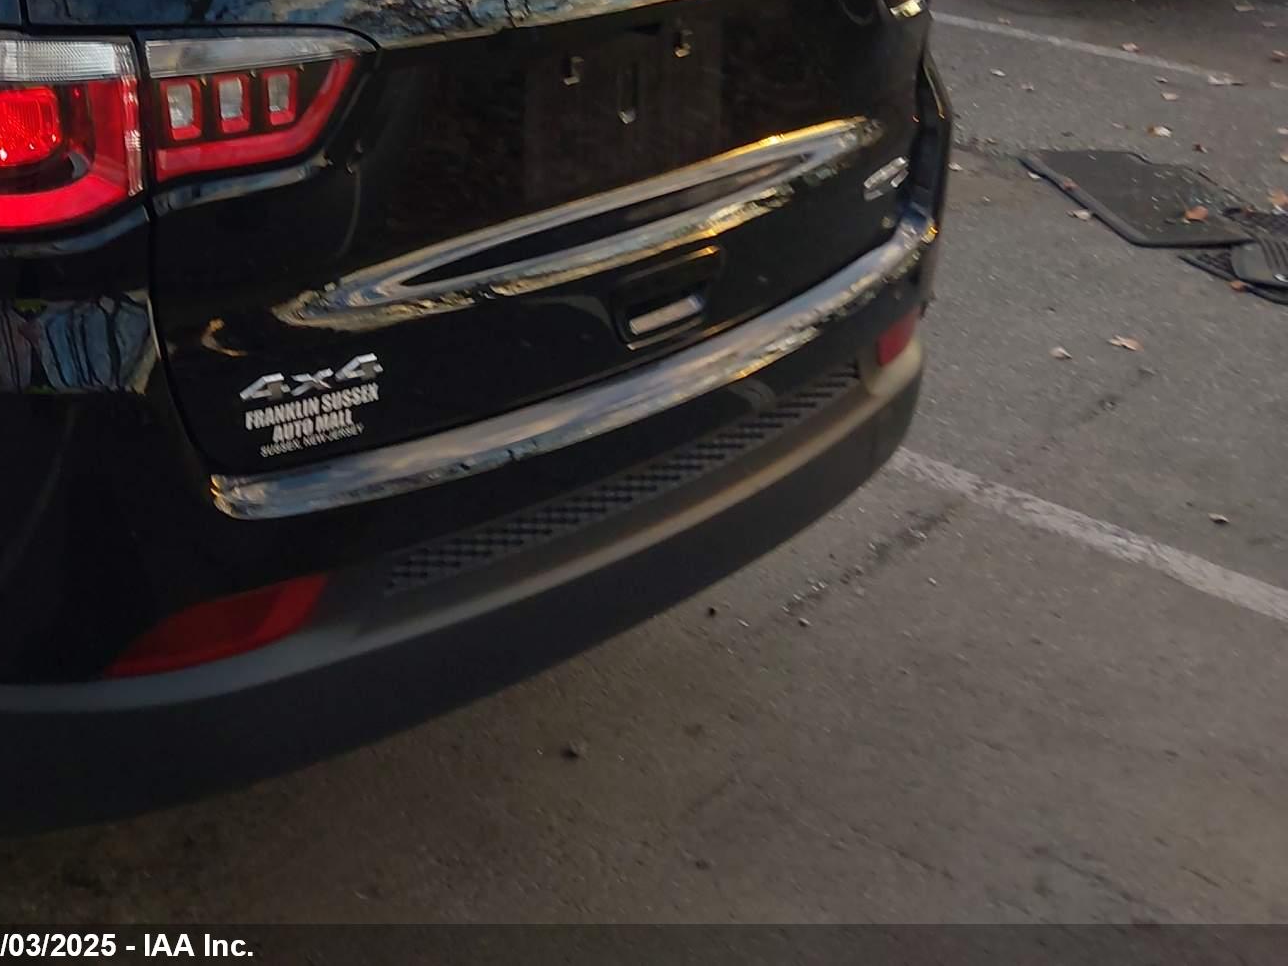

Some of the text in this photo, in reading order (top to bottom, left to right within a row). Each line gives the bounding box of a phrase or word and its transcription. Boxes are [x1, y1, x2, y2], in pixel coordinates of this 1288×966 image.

[245, 382, 379, 430] FRANKLIN SUSSEX
[272, 409, 353, 443] AUTO MALL
